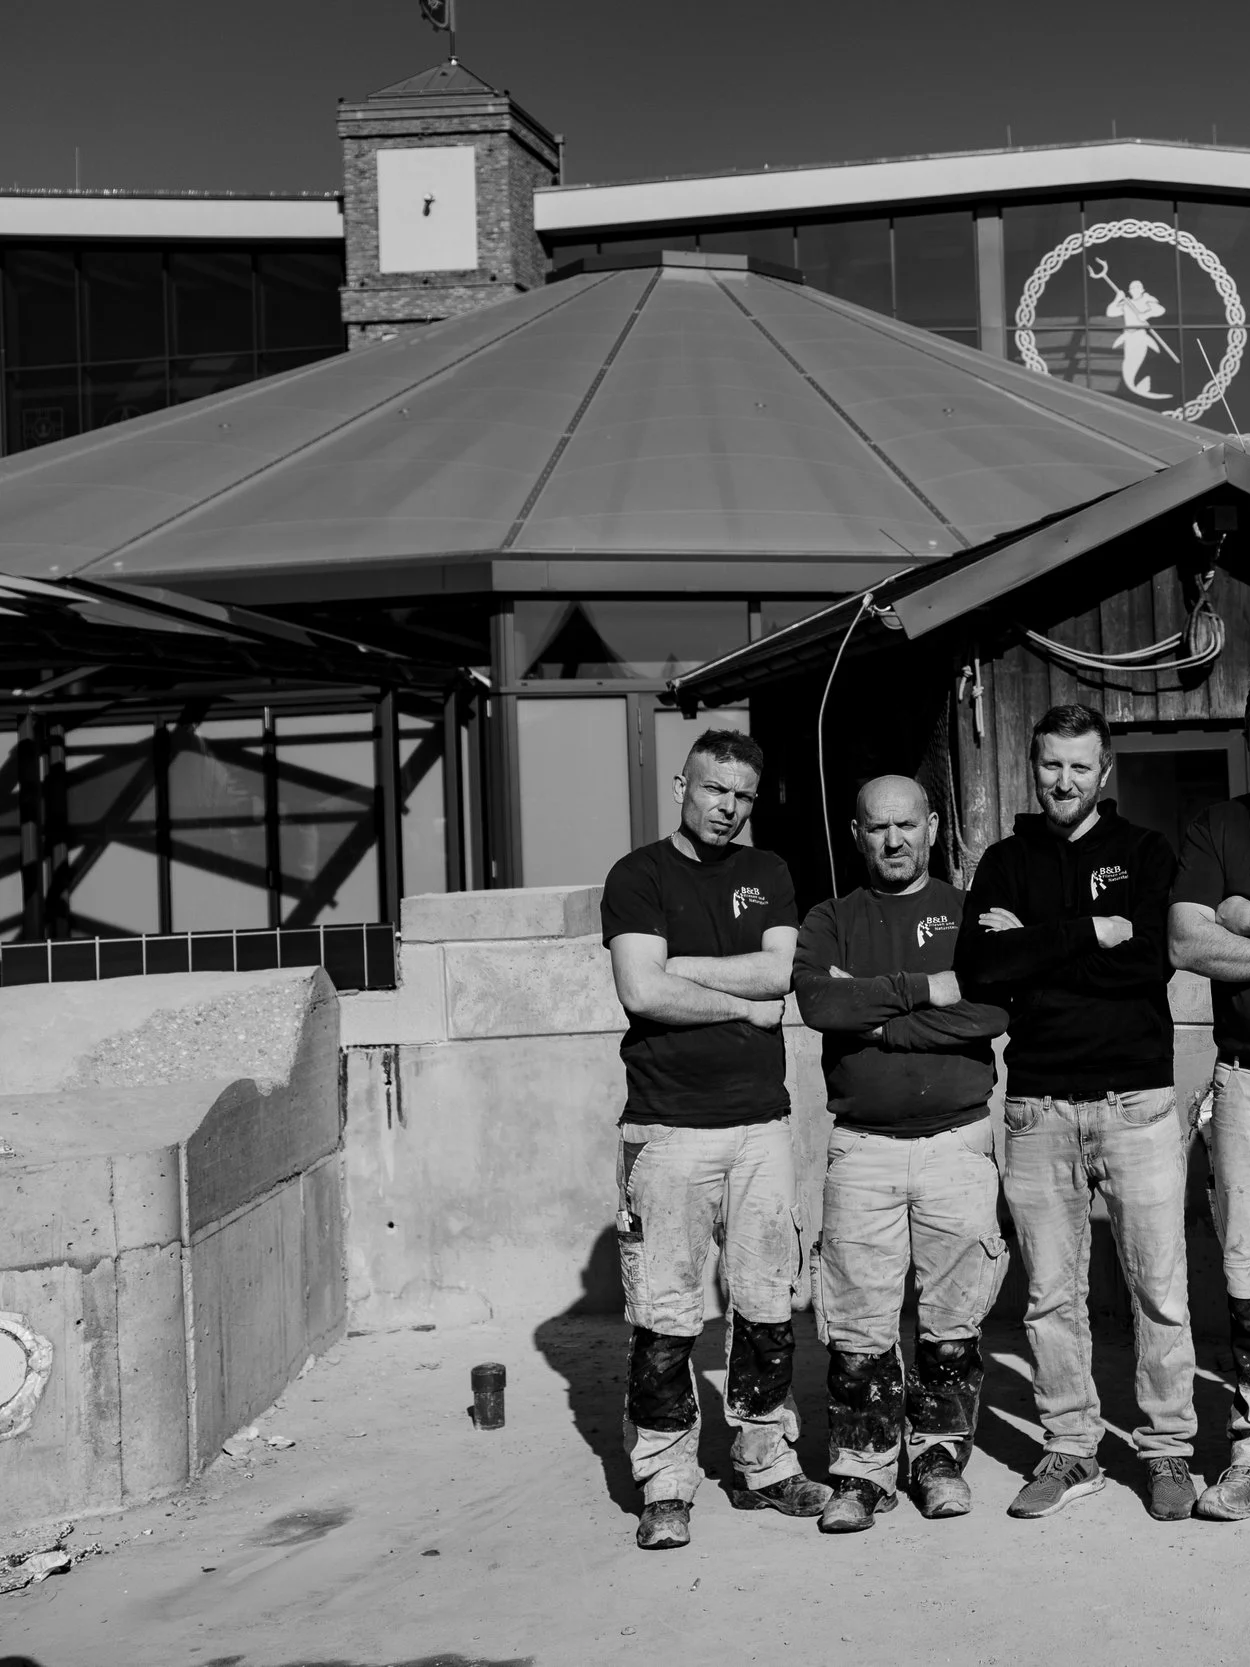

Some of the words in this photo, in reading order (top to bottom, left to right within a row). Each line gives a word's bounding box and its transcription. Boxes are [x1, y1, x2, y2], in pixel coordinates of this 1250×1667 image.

[1099, 865, 1121, 875] B&B
[741, 886, 760, 896] B&B
[926, 915, 948, 924] B&B
